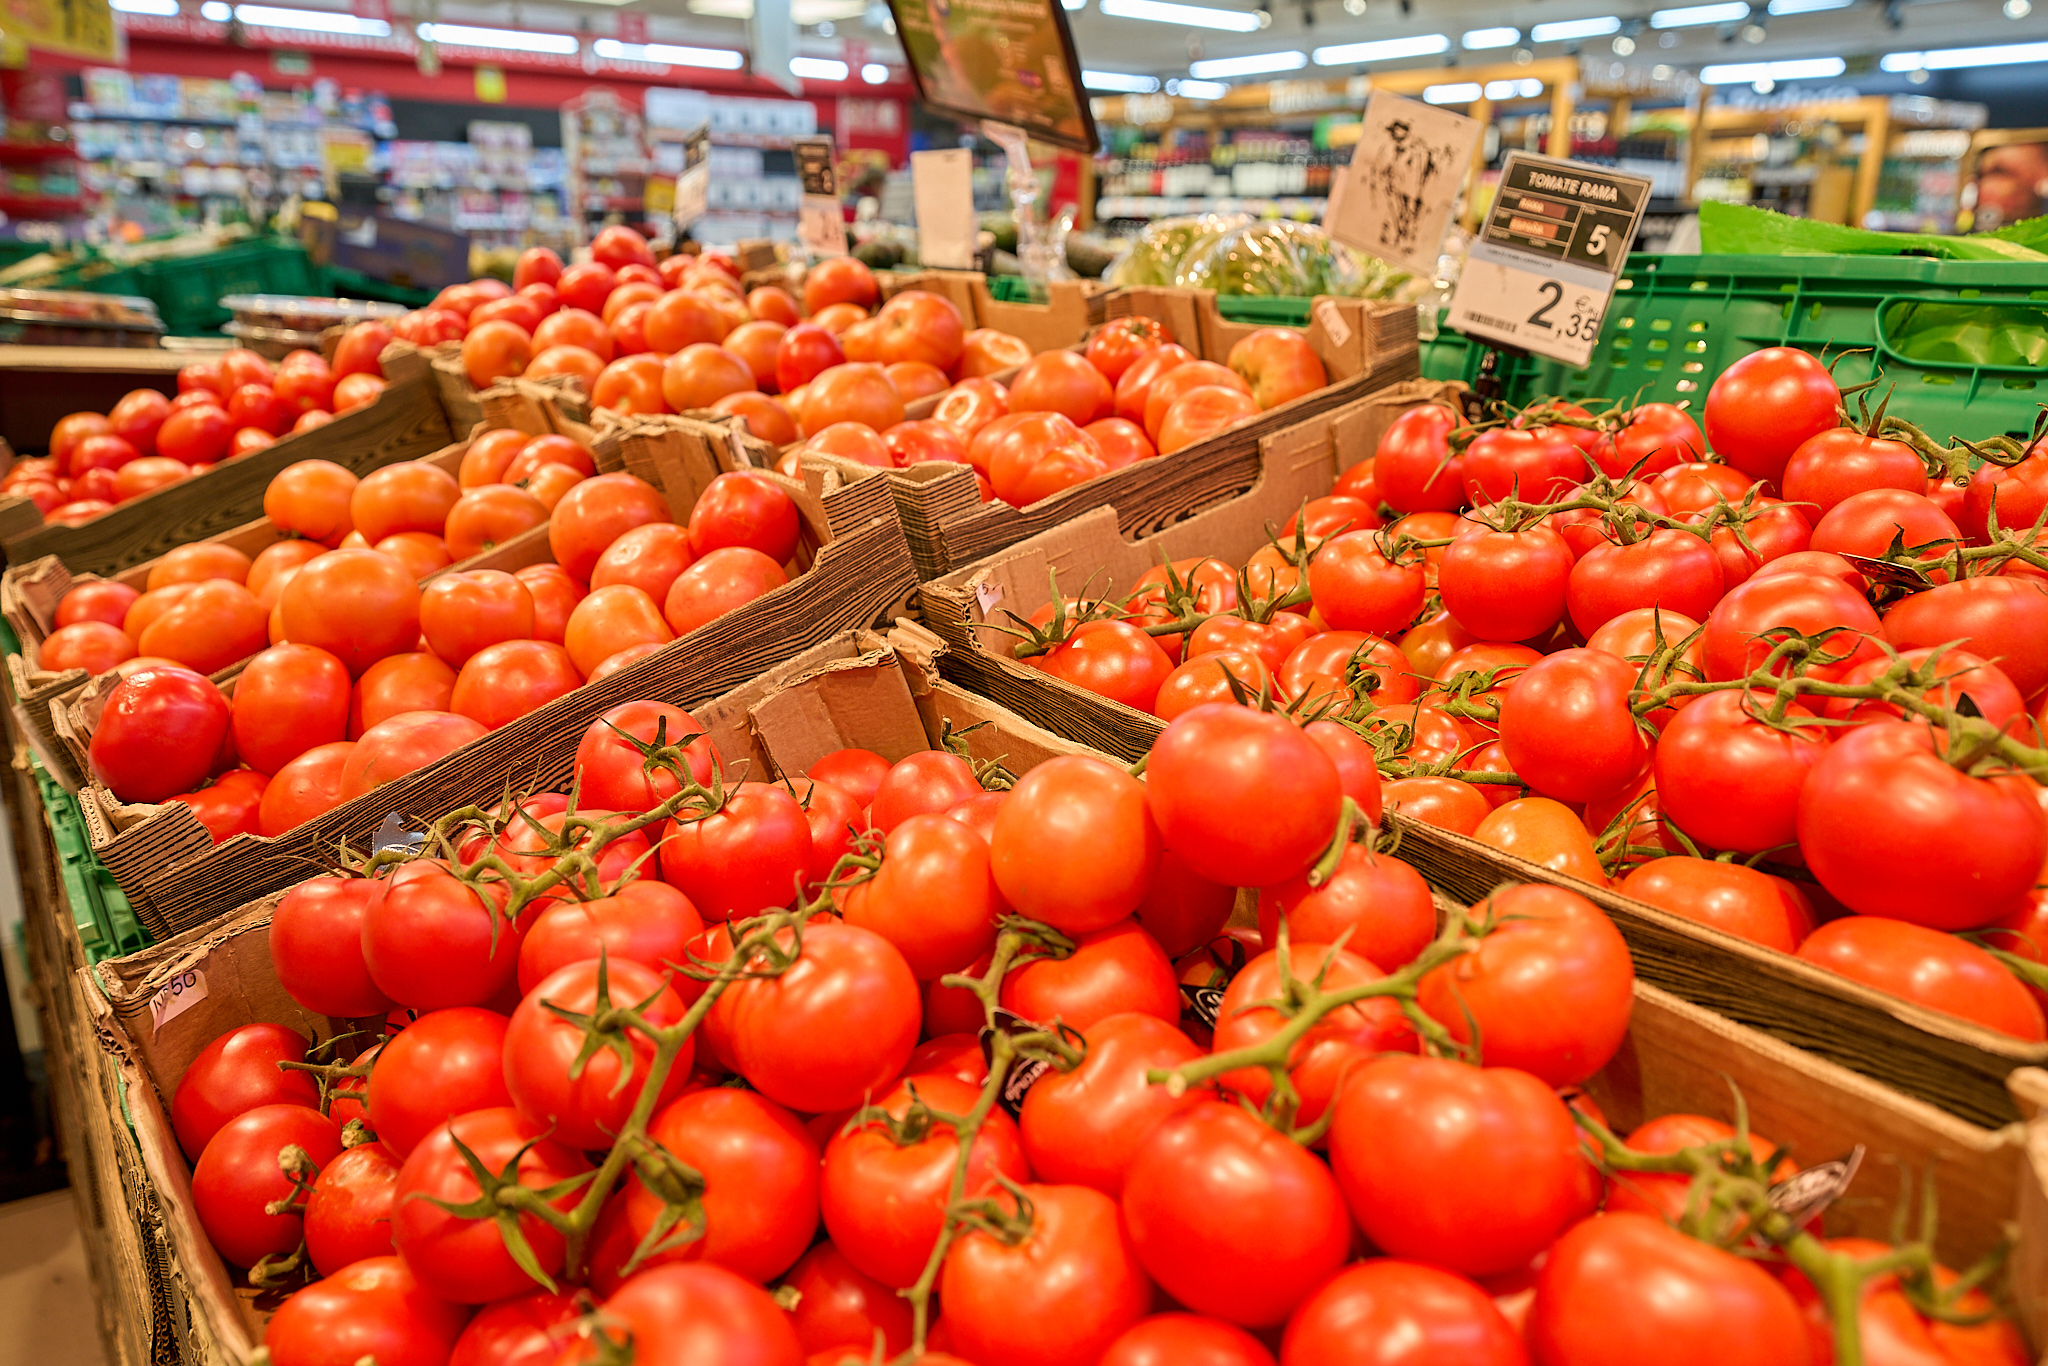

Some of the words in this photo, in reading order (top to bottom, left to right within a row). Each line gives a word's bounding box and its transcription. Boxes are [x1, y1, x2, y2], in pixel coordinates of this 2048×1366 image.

[1528, 171, 1580, 195] TOMATE
[1578, 181, 1618, 202] RAMA
[1585, 224, 1611, 256] 5
